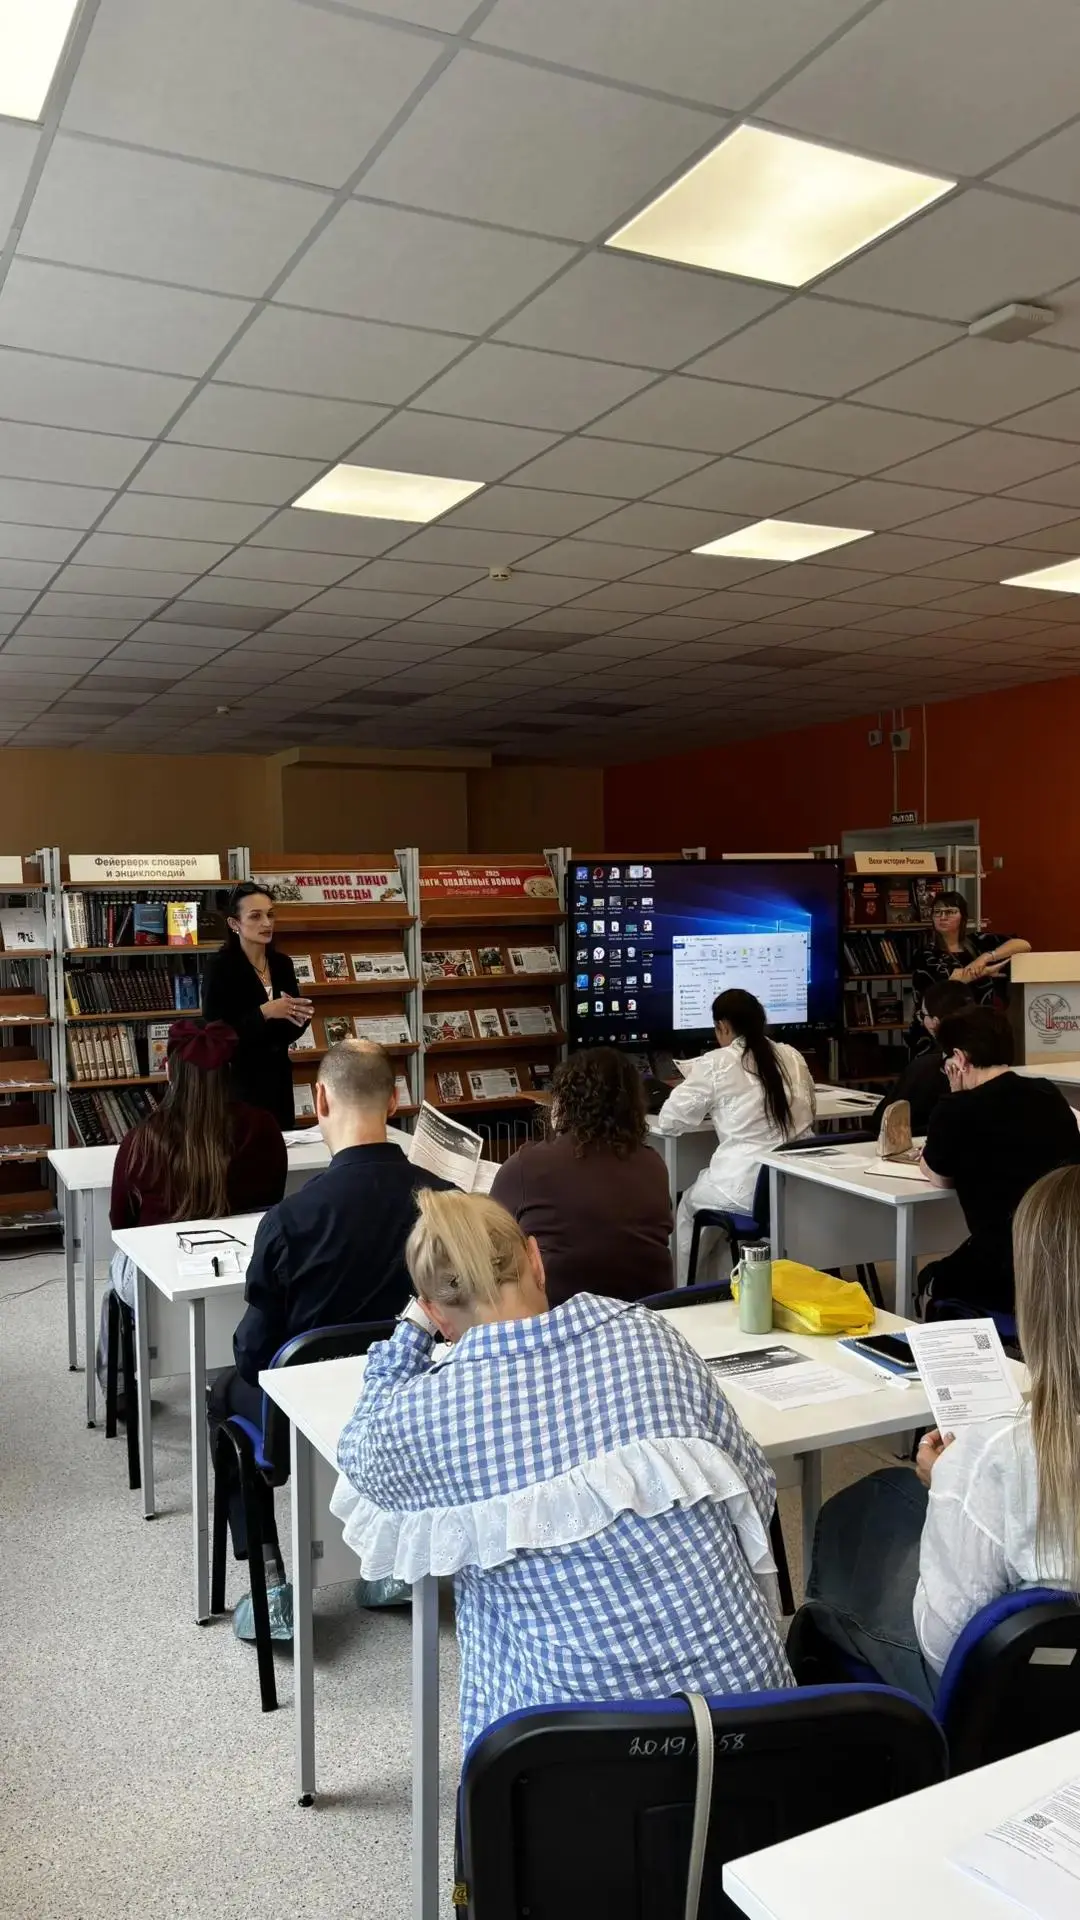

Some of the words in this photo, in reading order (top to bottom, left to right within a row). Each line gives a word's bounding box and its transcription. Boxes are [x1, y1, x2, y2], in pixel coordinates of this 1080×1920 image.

[94, 857, 149, 868] Фейерверк
[151, 857, 197, 868] словарей
[906, 856, 925, 865] России
[115, 869, 185, 878] энциклопедий
[295, 875, 353, 887] ЖЕНСКОЕ
[356, 874, 388, 887] ЛИЦО
[322, 889, 373, 900] ПОБЕДЫ
